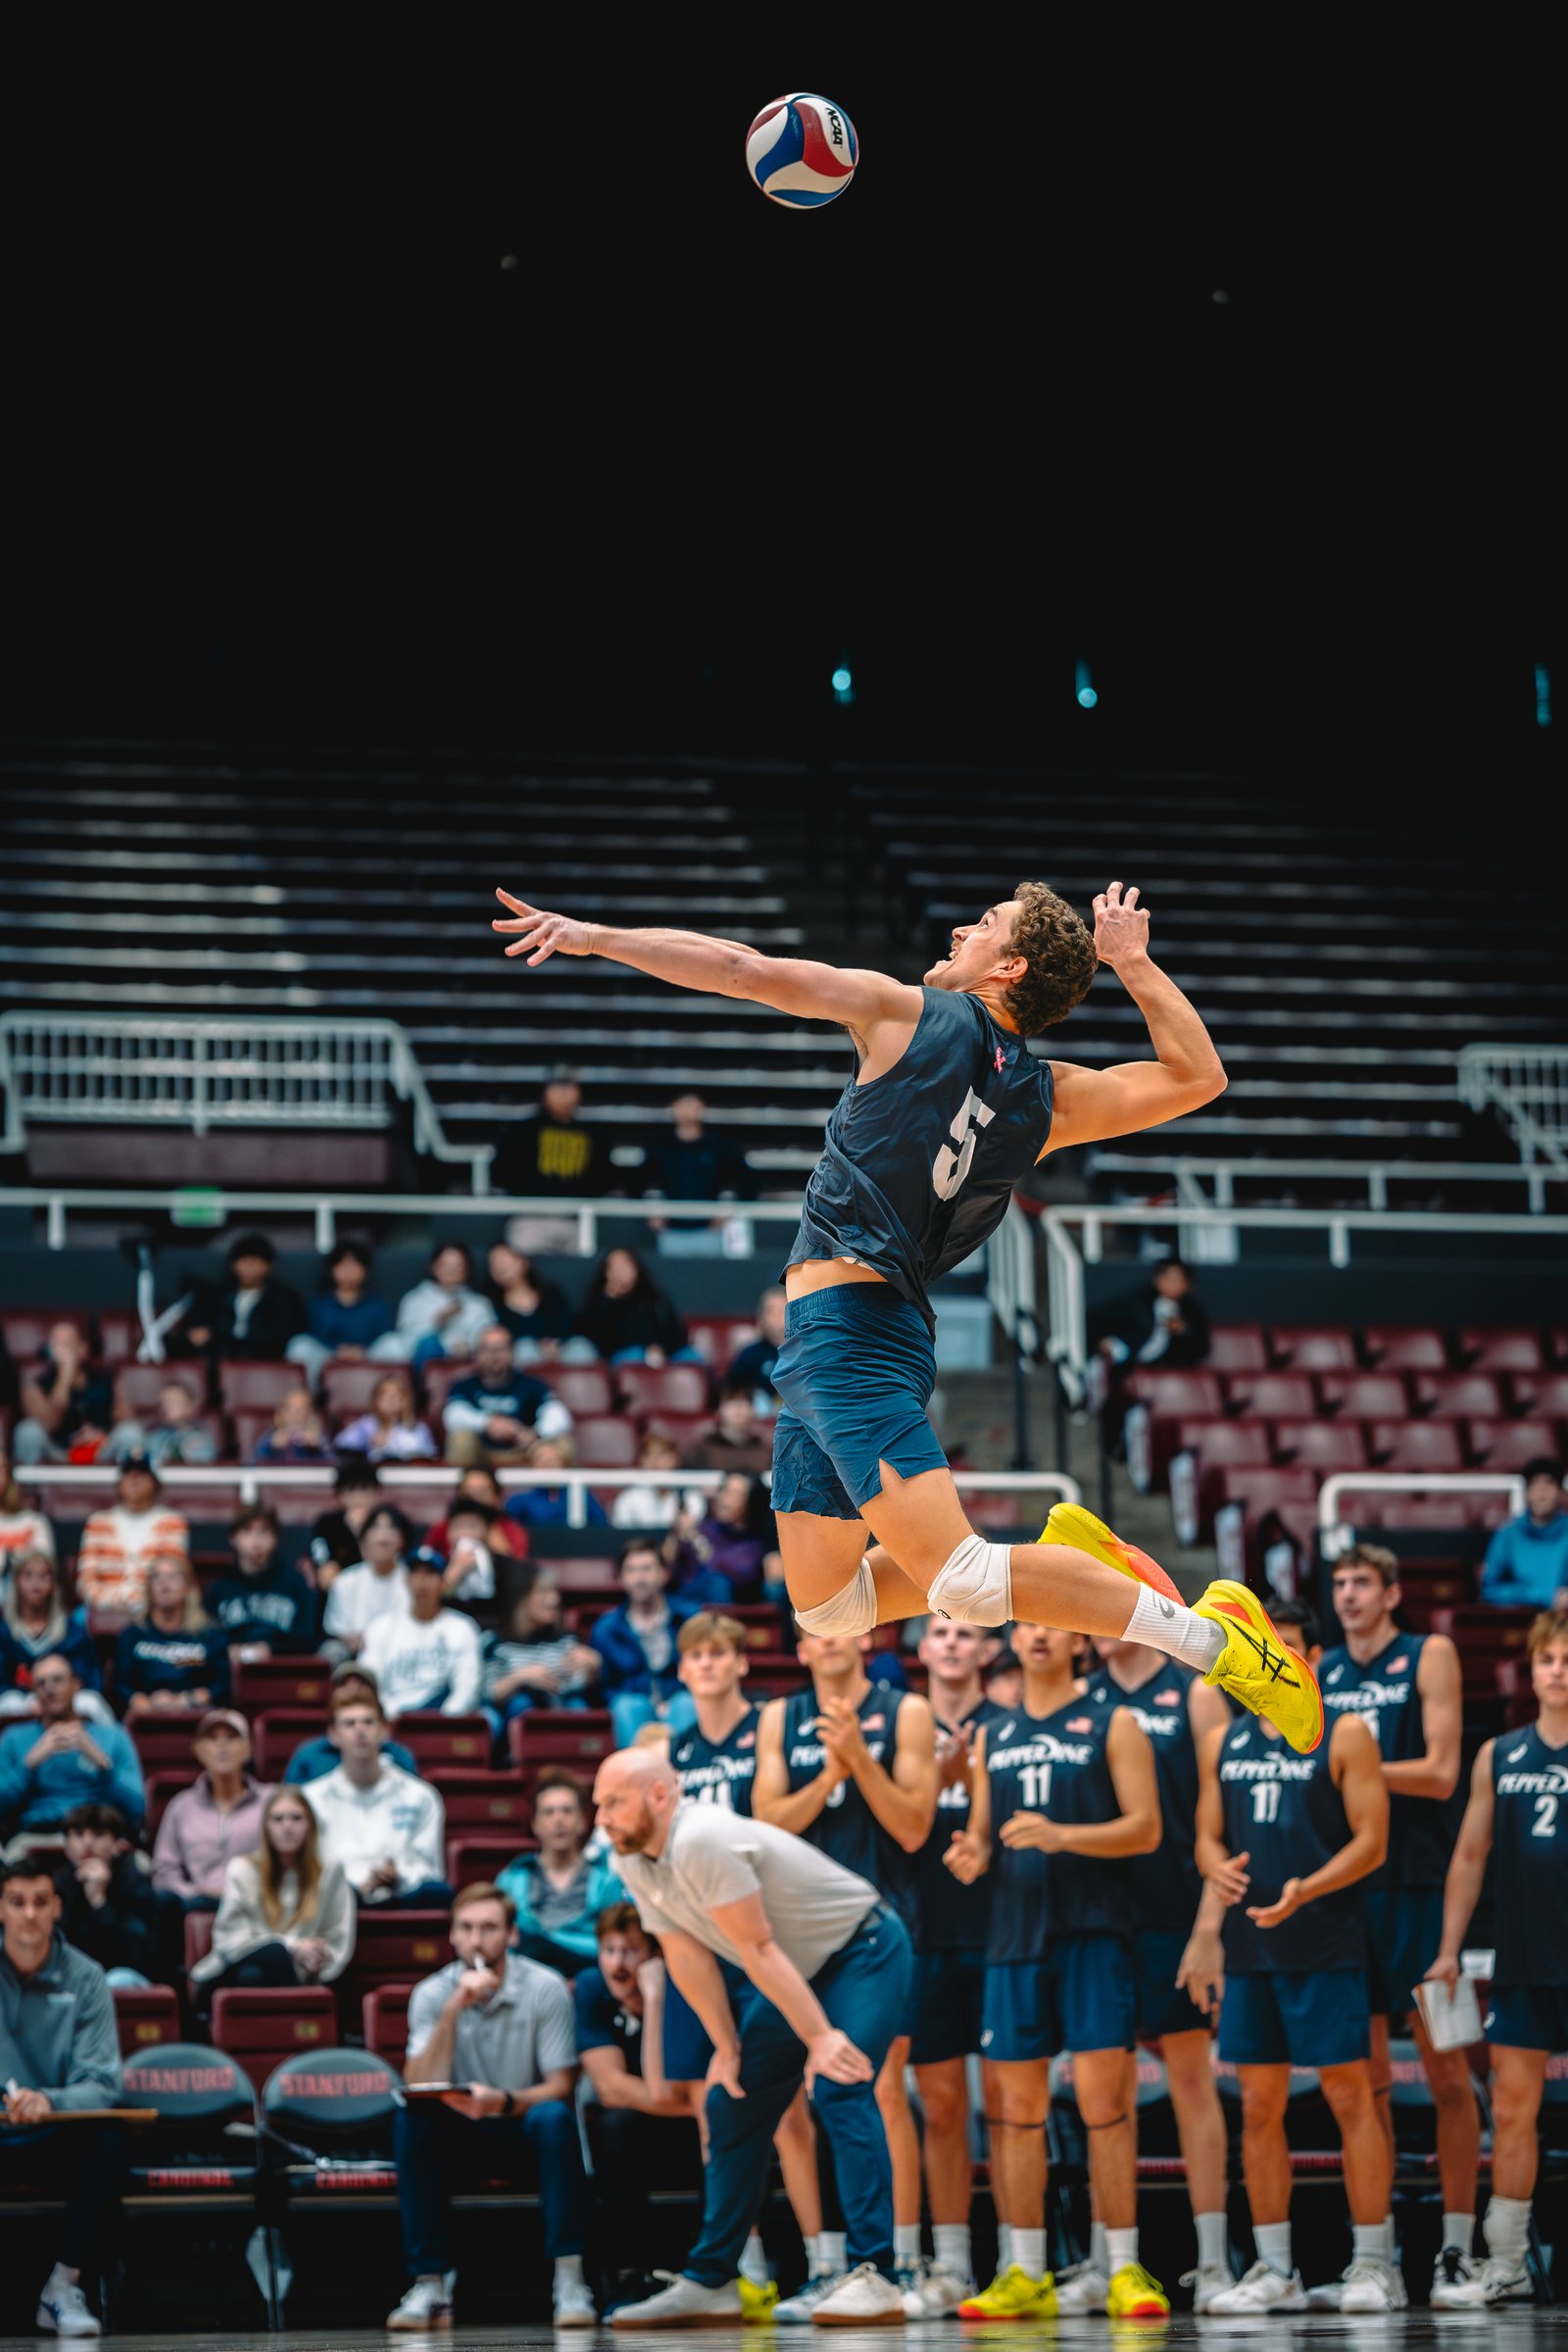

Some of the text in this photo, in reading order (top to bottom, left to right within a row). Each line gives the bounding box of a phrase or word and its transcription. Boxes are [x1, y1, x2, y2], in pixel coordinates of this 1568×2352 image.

[825, 107, 843, 146] NCAA
[933, 1085, 997, 1202] 5
[987, 1734, 1093, 1773] PEPPERDINE
[1220, 1750, 1317, 1783] PEPPERDINE
[1016, 1763, 1053, 1808] 11
[1531, 1793, 1559, 1838] 2
[123, 2066, 234, 2093] STANFORD
[280, 2070, 390, 2098] STANFORD
